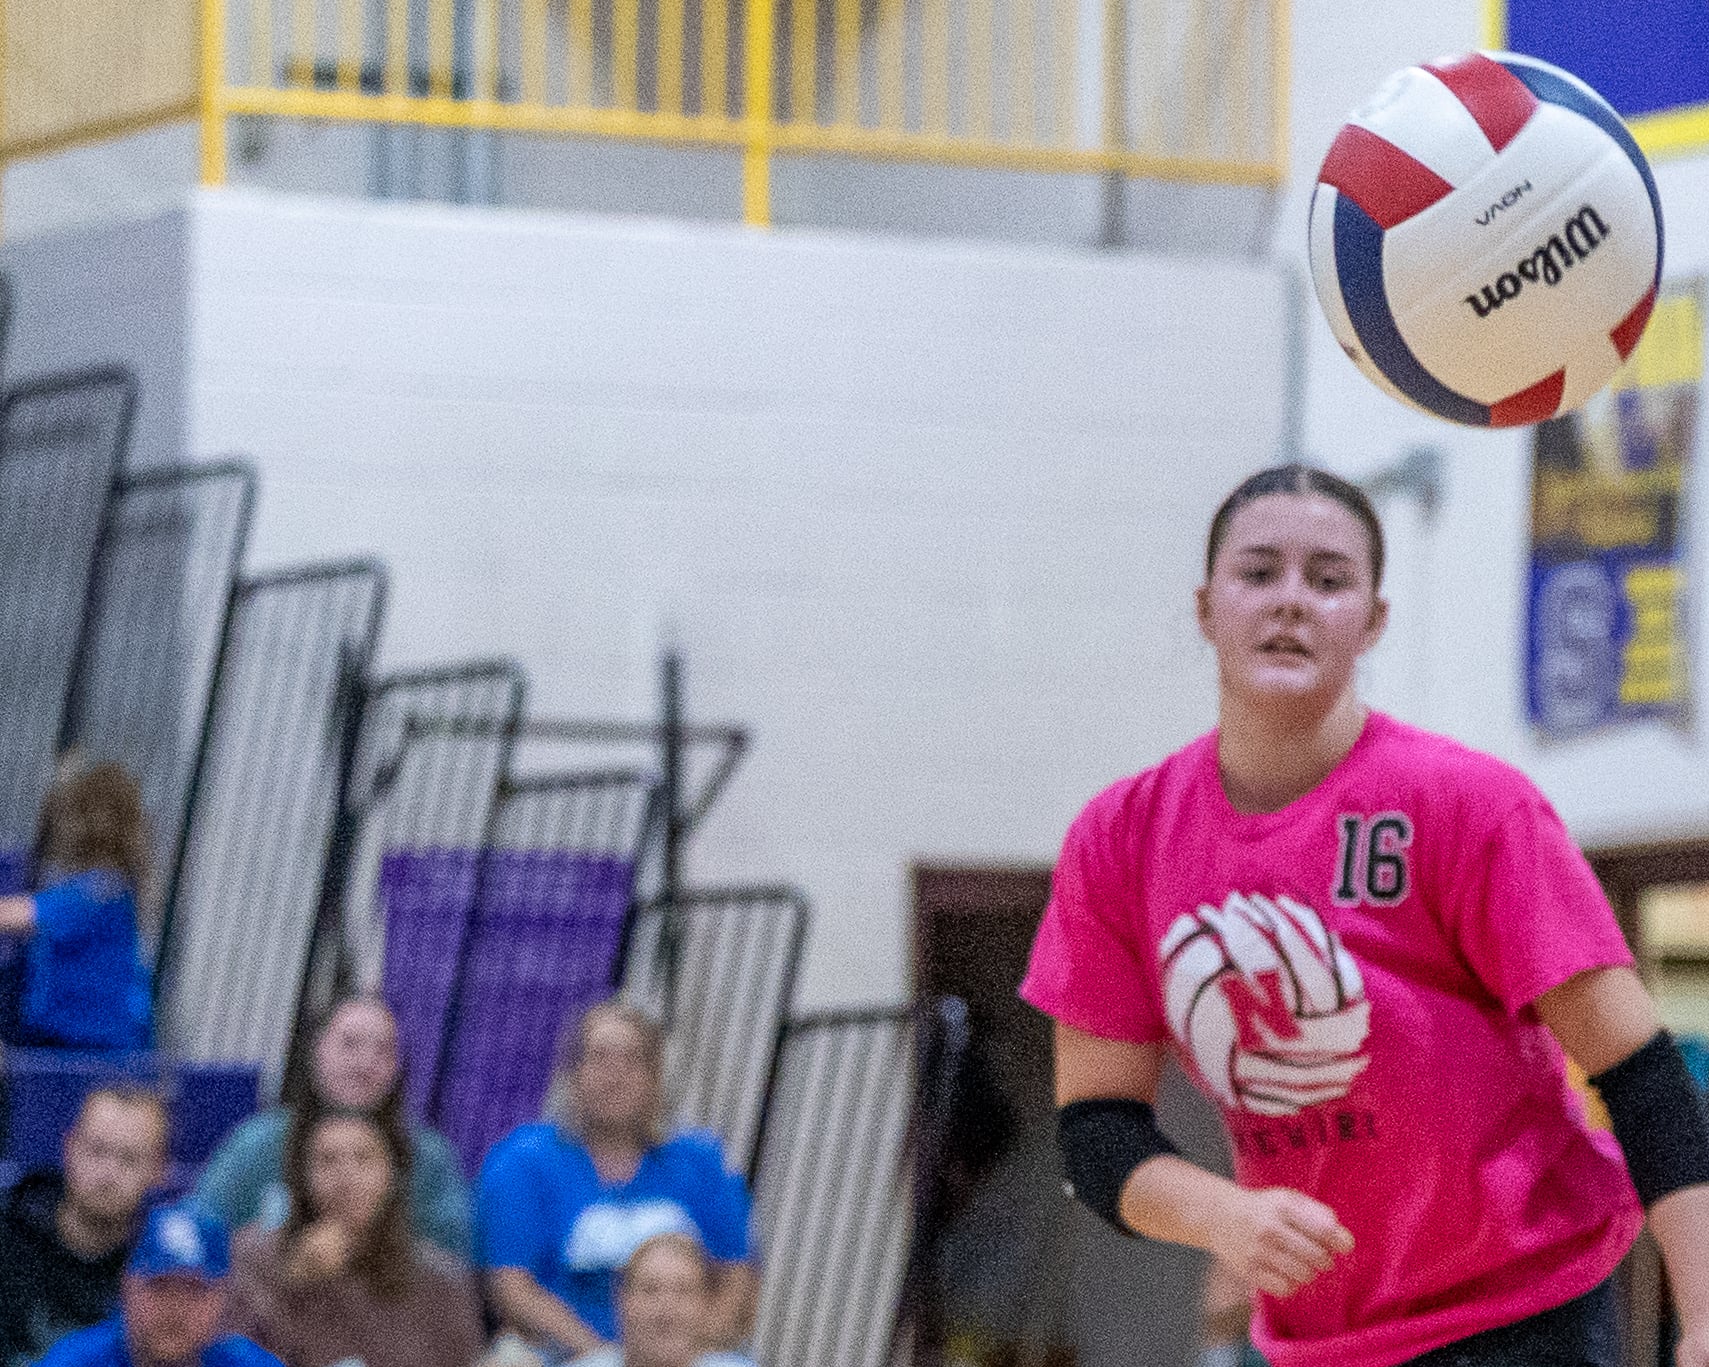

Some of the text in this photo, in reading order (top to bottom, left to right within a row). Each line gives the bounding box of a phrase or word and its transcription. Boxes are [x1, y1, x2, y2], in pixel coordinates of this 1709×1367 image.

[1475, 179, 1532, 226] NOVA
[1463, 203, 1610, 318] Wilson
[1330, 810, 1414, 908] 16
[1217, 970, 1302, 1050] N
